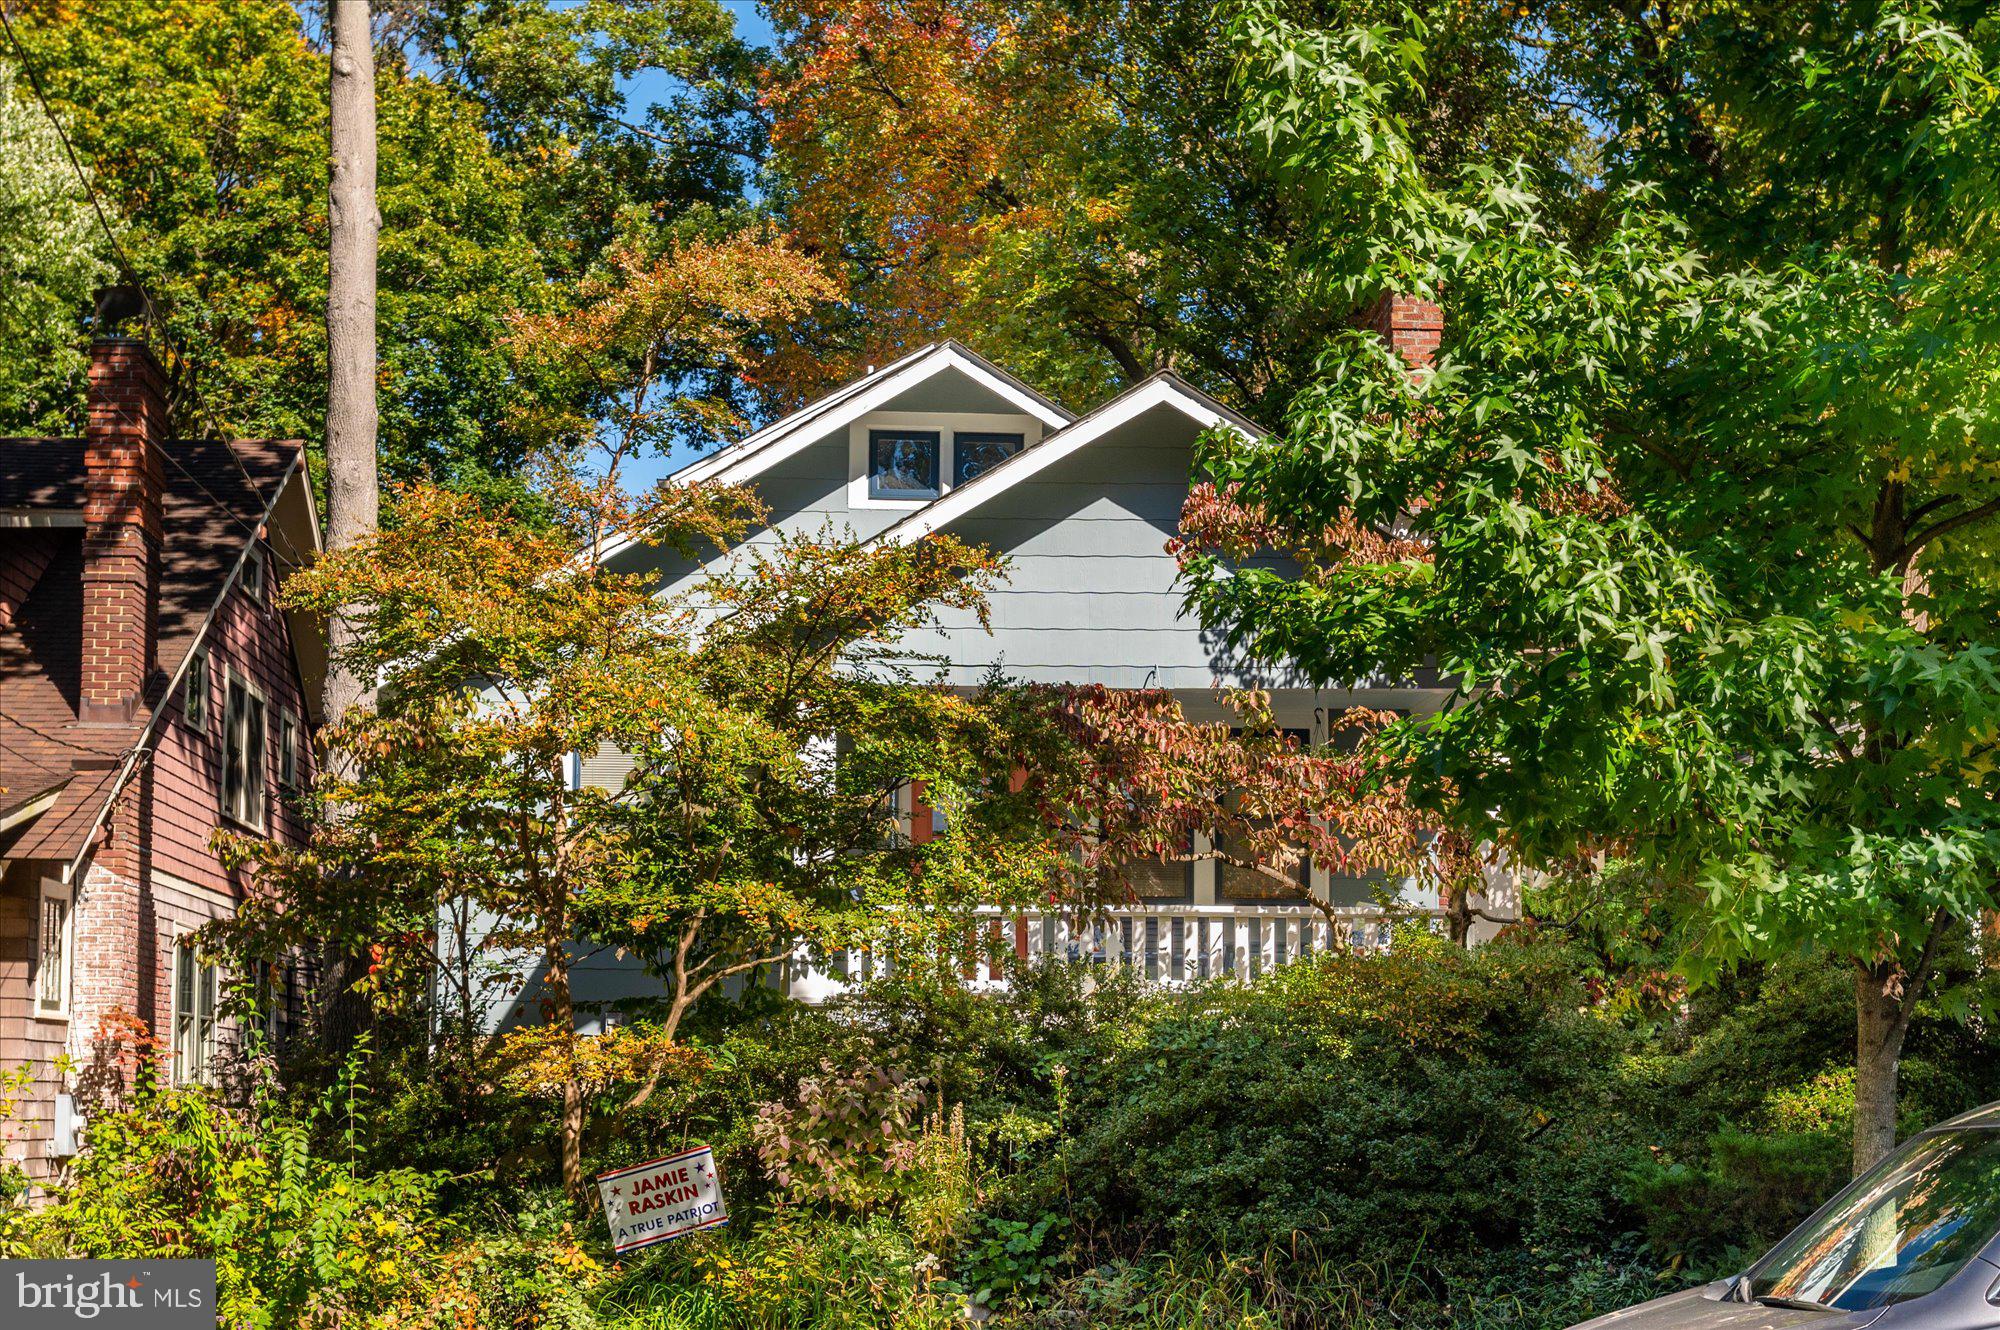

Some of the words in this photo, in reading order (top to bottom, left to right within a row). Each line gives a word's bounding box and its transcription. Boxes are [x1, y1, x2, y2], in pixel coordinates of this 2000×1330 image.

[632, 1167, 690, 1196] JAMIE
[628, 1183, 699, 1216] RASKIN
[618, 1228, 629, 1239] A
[630, 1217, 664, 1235] TRUE
[667, 1201, 719, 1225] PATRIOT
